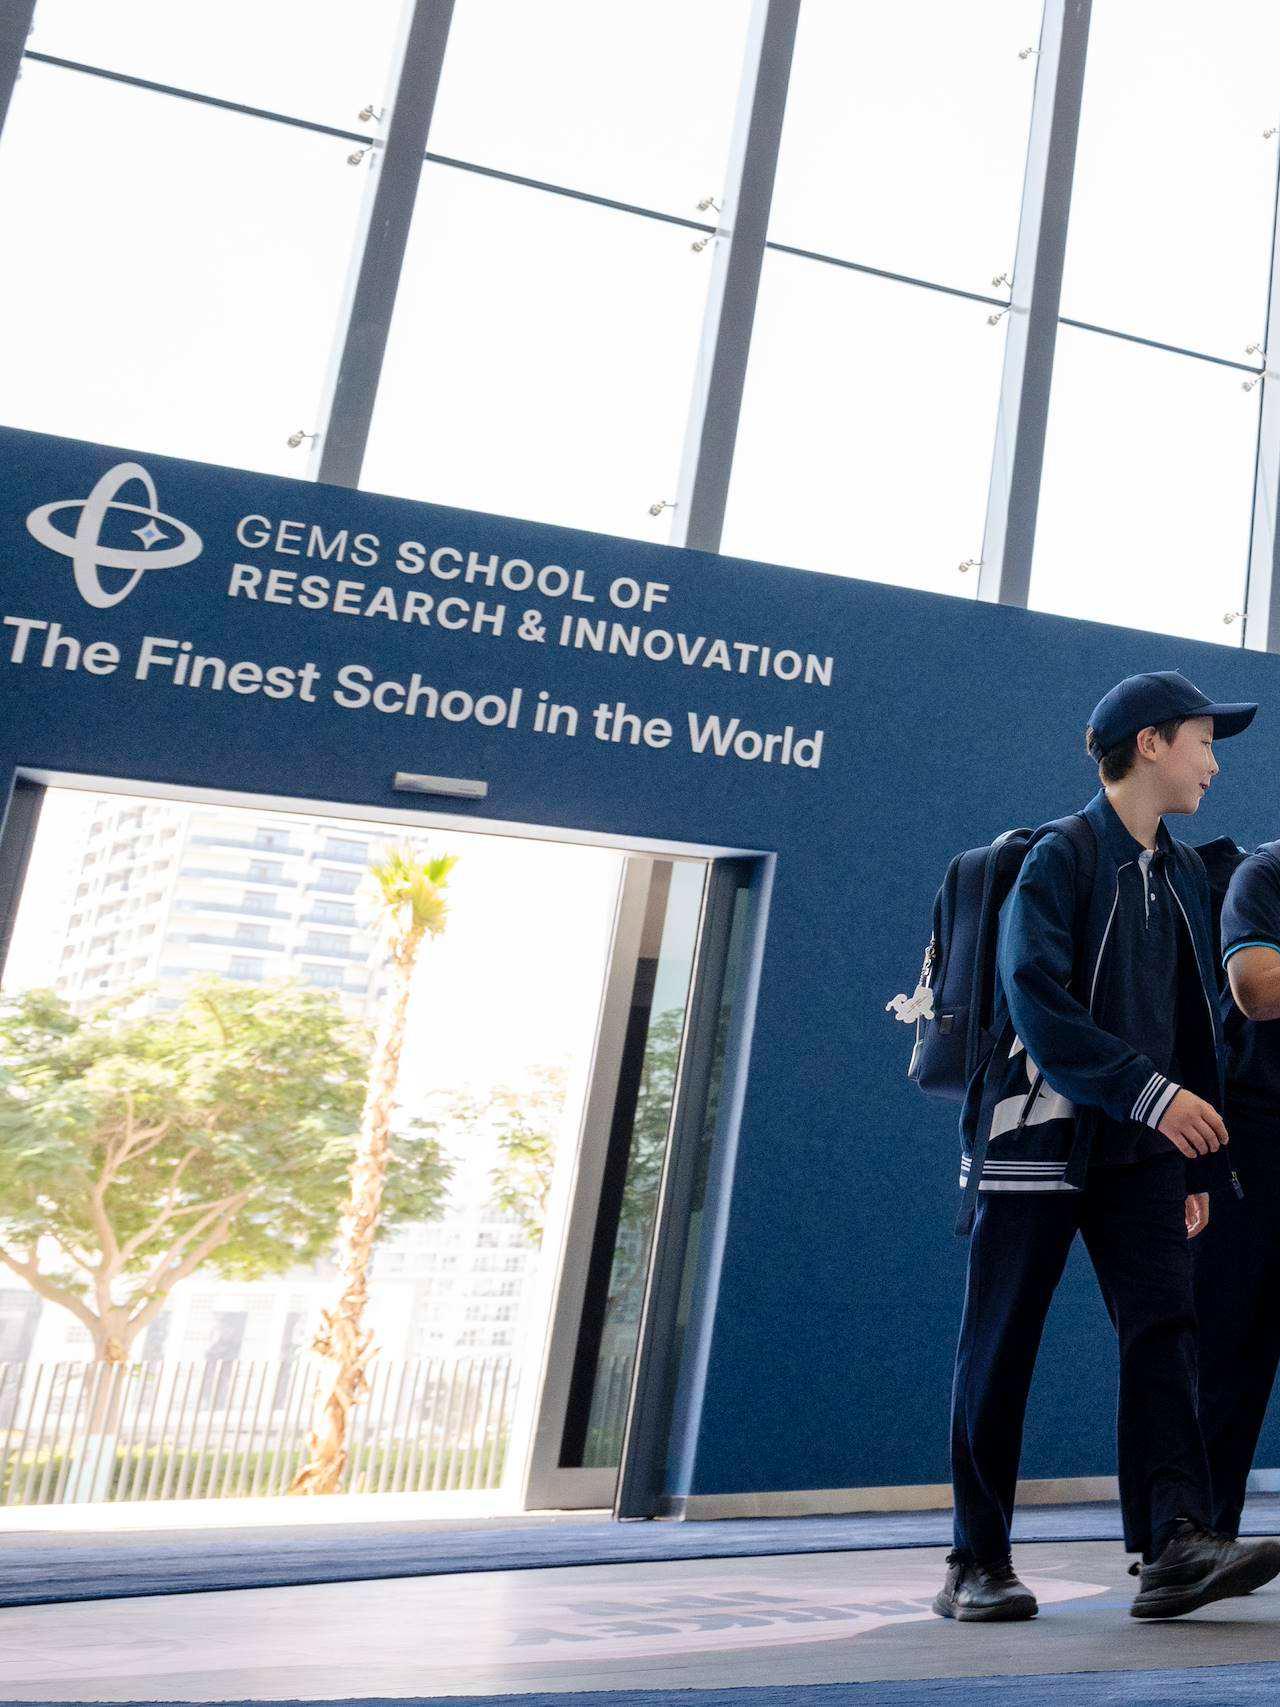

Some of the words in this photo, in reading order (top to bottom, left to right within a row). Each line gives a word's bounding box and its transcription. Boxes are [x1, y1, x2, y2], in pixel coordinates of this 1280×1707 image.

[237, 515, 380, 567] GEMS
[396, 542, 595, 603] SCHOOL
[609, 577, 670, 612] OF
[228, 564, 506, 636] RESEARCH
[518, 609, 546, 643] &
[559, 616, 834, 686] INNOVATION
[3, 617, 120, 675] The
[135, 637, 321, 703] Finest
[333, 664, 523, 729] School
[533, 694, 579, 737] in
[592, 703, 673, 748] the
[688, 713, 824, 769] World
